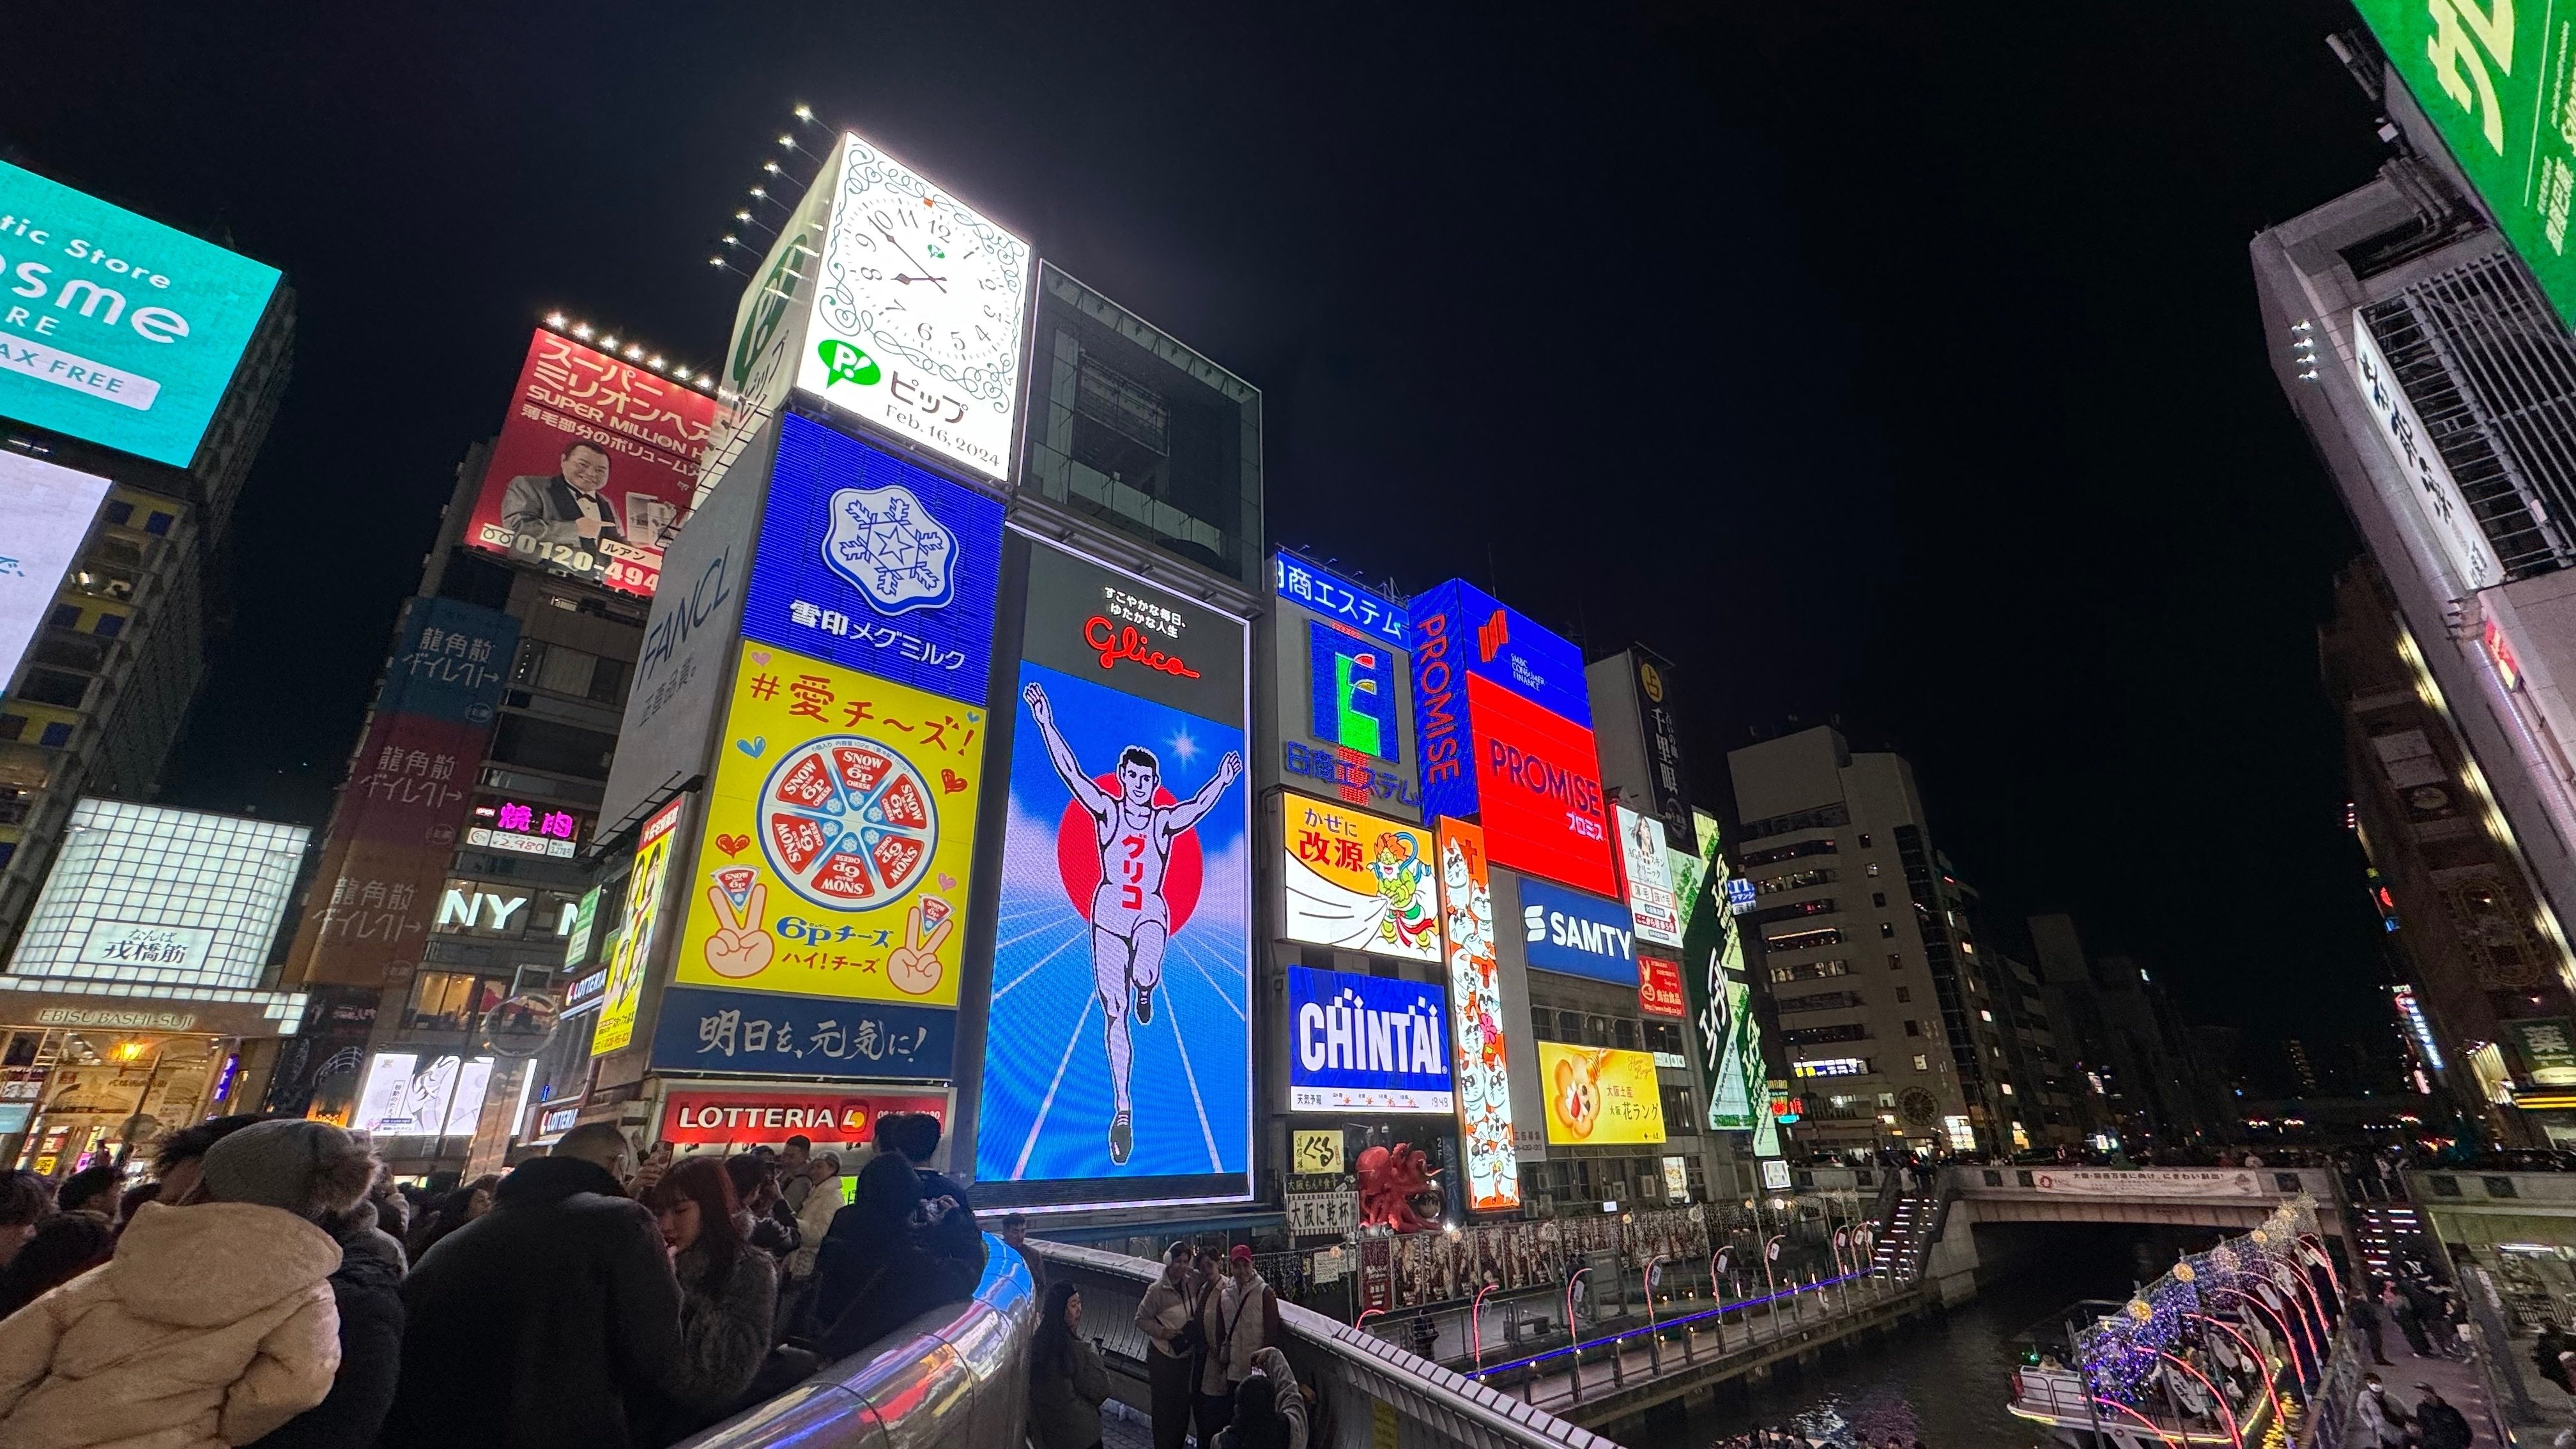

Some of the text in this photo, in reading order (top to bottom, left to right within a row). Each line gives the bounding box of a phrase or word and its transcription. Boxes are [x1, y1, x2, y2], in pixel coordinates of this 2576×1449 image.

[867, 210, 893, 231] 10
[897, 208, 919, 229] 11
[928, 218, 951, 243] 12
[855, 233, 876, 252] 9
[64, 238, 171, 289] Store
[861, 267, 882, 280] 8
[0, 254, 190, 344] sme
[977, 279, 996, 291] 2
[885, 298, 907, 311] 7
[983, 305, 1002, 323] 3
[5, 305, 60, 336] RE
[917, 323, 933, 341] 6
[975, 325, 991, 342] 4
[950, 332, 966, 351] 5
[49, 360, 125, 394] FREE
[539, 337, 663, 397] スーパー
[891, 371, 969, 424] ピップ
[527, 384, 603, 423] SUPER
[609, 418, 687, 456] MILLION
[886, 404, 1000, 467] Feb. 16, 2024
[516, 533, 660, 592] 0120-494
[605, 542, 646, 561] ルアン
[636, 544, 732, 691] FANCL
[1103, 586, 1187, 628] すこやかな毎日、
[1109, 602, 1179, 639] ゆたかな人生
[418, 625, 496, 664] 龍角散
[790, 599, 966, 671] 雪印メグミルク
[1084, 615, 1201, 680] Glico
[1418, 612, 1460, 785] PROMISE
[378, 744, 458, 781] 龍角散
[843, 751, 884, 769] SNOW
[784, 759, 817, 795] SNOW
[846, 779, 871, 790] CHEESE
[1490, 738, 1602, 818] PROMISE
[813, 785, 832, 806] CHEESE
[882, 798, 896, 822] CHEESE
[900, 783, 924, 821] SNOW
[498, 802, 573, 838] 焼肉
[809, 821, 824, 847] CHEESE
[1305, 808, 1358, 838] かぜに
[1565, 812, 1604, 841] プロミス
[775, 823, 802, 863] SNOW
[874, 836, 892, 857] CHEESE
[1298, 829, 1364, 873] 改源
[834, 854, 861, 864] CHEESE
[890, 846, 918, 883] SNOW
[1121, 832, 1147, 911] グリコ
[330, 875, 419, 911] 龍角散
[820, 878, 864, 894] SNOW
[129, 928, 177, 944] なんば
[1550, 911, 1631, 960] SAMTY
[101, 940, 190, 965] 戎橋筋
[39, 1009, 95, 1023] EBISU
[1299, 987, 1443, 1075] CHINTAI
[696, 1008, 928, 1063] 明日を、元気に!
[1296, 1094, 1322, 1105] 天気予報
[678, 1105, 836, 1130] LOTTERIA
[1303, 1136, 1335, 1167] くくる
[1291, 1198, 1350, 1228] 大阪に乾杯
